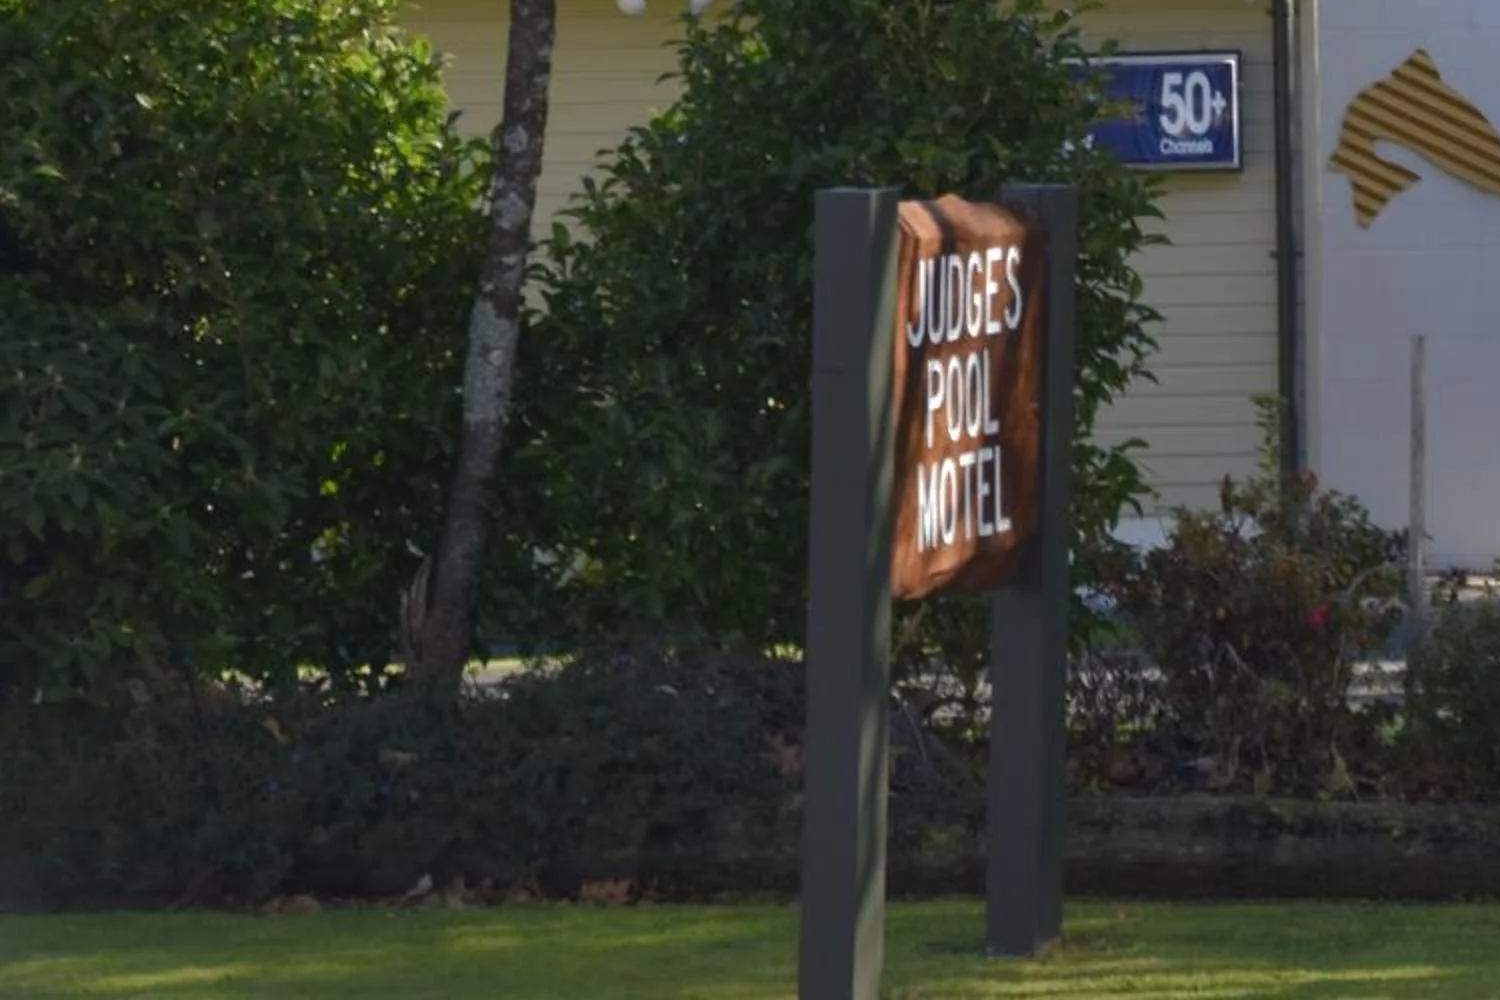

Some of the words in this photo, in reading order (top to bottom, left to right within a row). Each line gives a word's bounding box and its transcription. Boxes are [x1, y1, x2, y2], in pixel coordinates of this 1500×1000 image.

[1160, 71, 1226, 136] 50+
[907, 245, 1023, 348] JUDGES
[926, 347, 999, 448] POOL
[916, 445, 1012, 553] MOTEL
